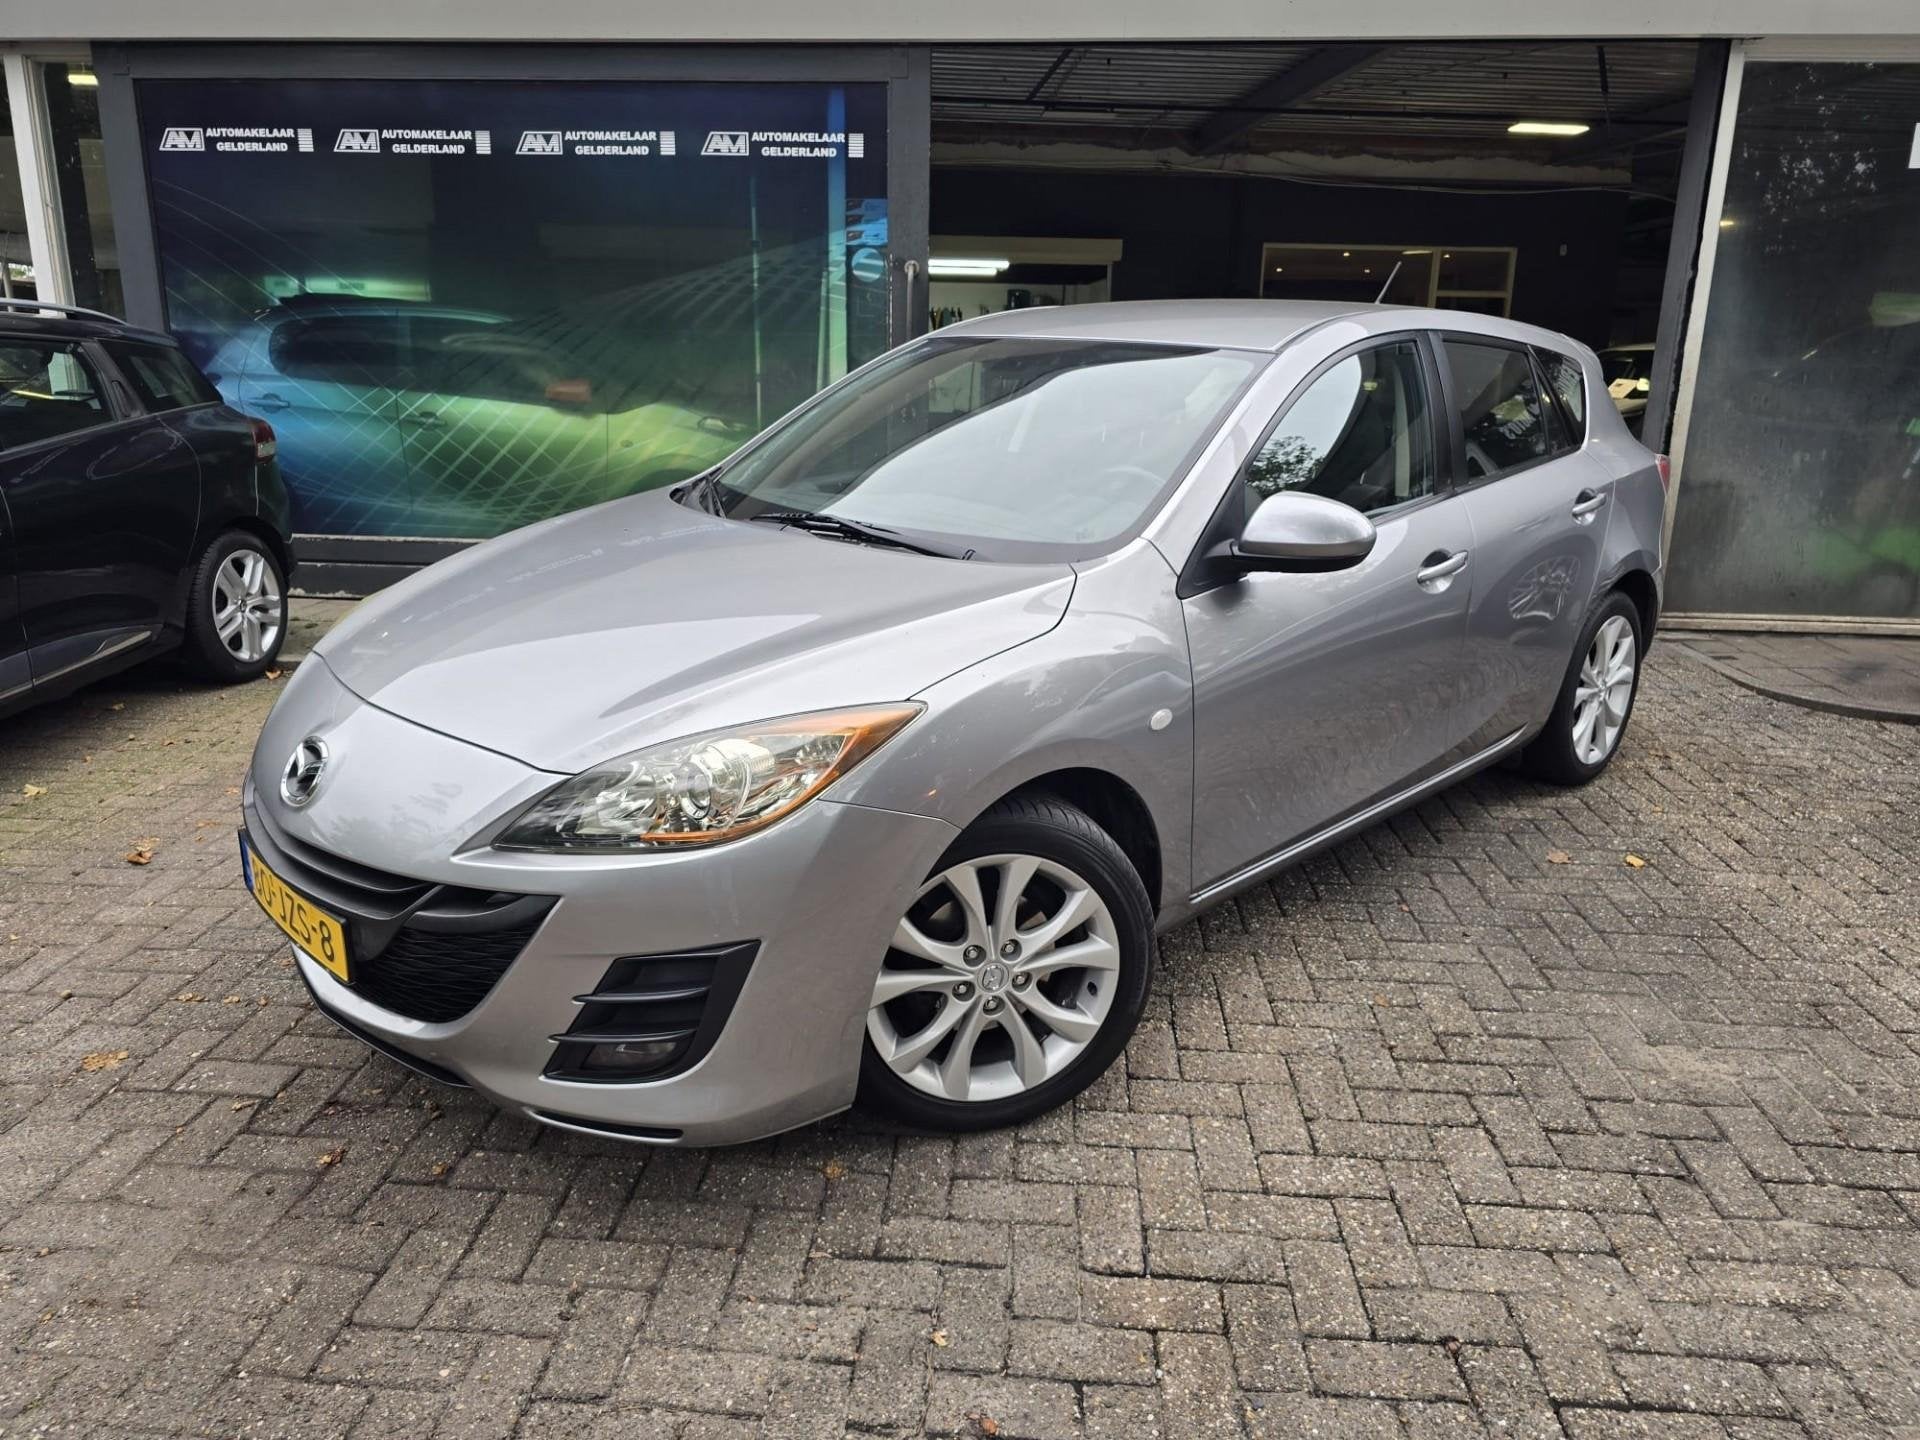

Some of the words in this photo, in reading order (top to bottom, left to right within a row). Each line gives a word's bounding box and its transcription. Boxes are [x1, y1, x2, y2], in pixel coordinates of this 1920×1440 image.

[206, 128, 294, 137] AUTOMAKELAAR
[382, 130, 472, 139] AUTOMAKELAAR
[565, 131, 656, 141] AUTOMAKELAAR
[752, 132, 845, 142] AUTOMAKELAAR
[216, 142, 288, 151] GELDERLAND
[392, 144, 465, 154] GELDERLAND
[575, 146, 649, 155] GELDERLAND
[761, 147, 837, 157] GELDERLAND
